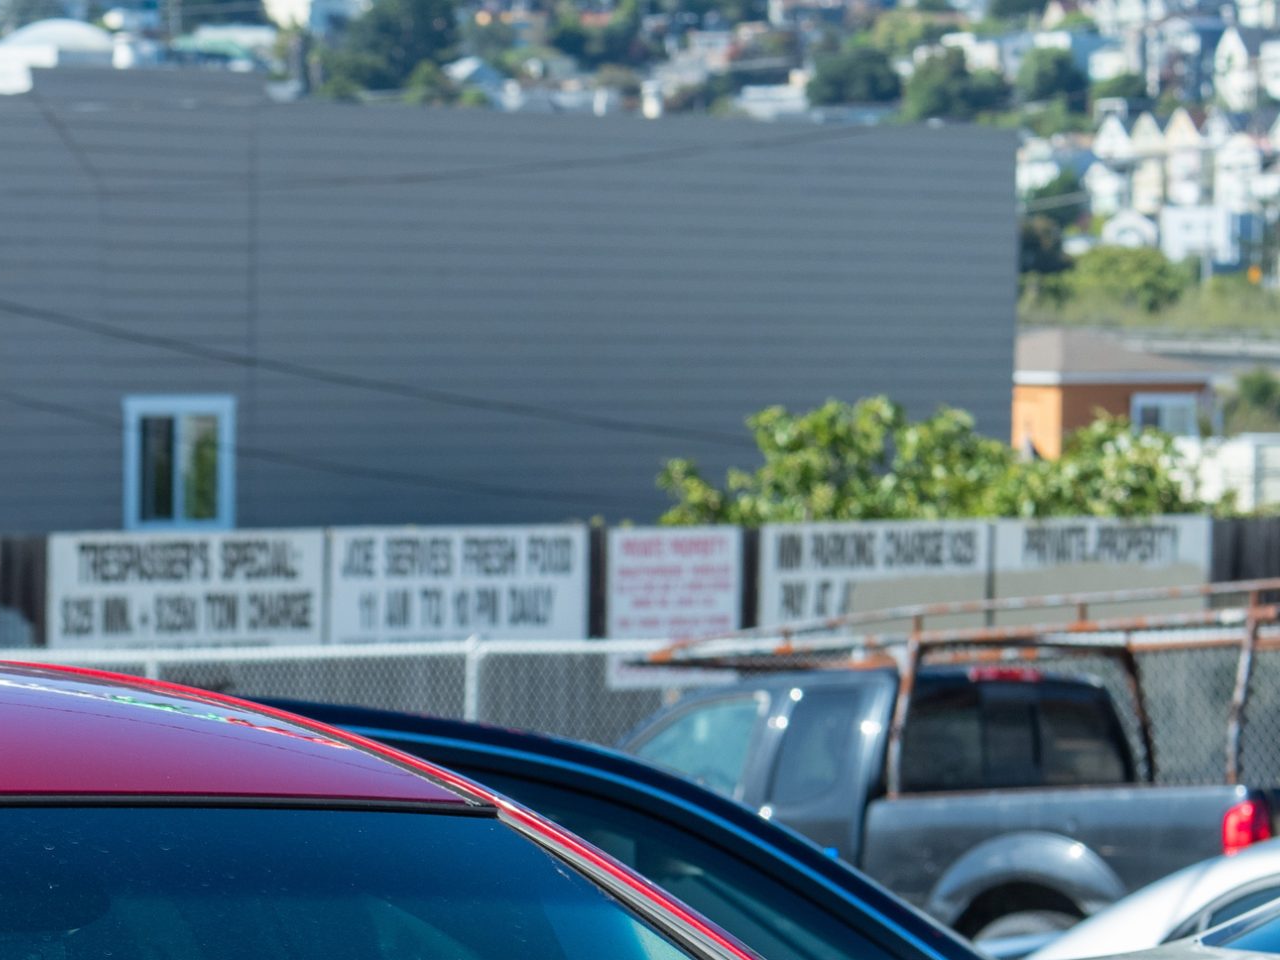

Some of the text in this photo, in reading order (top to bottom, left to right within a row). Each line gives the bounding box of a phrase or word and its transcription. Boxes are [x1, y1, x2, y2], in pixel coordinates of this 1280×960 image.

[384, 537, 453, 577] SERVES
[461, 536, 518, 576] FRESH
[526, 536, 573, 575] FOOD
[813, 531, 875, 569] PARKING
[884, 529, 944, 567] CHARGE
[1021, 524, 1179, 563] PRIVATE PROPERTY
[247, 590, 313, 630] CHARGE
[476, 586, 501, 625] PM
[508, 584, 554, 626] DAILY
